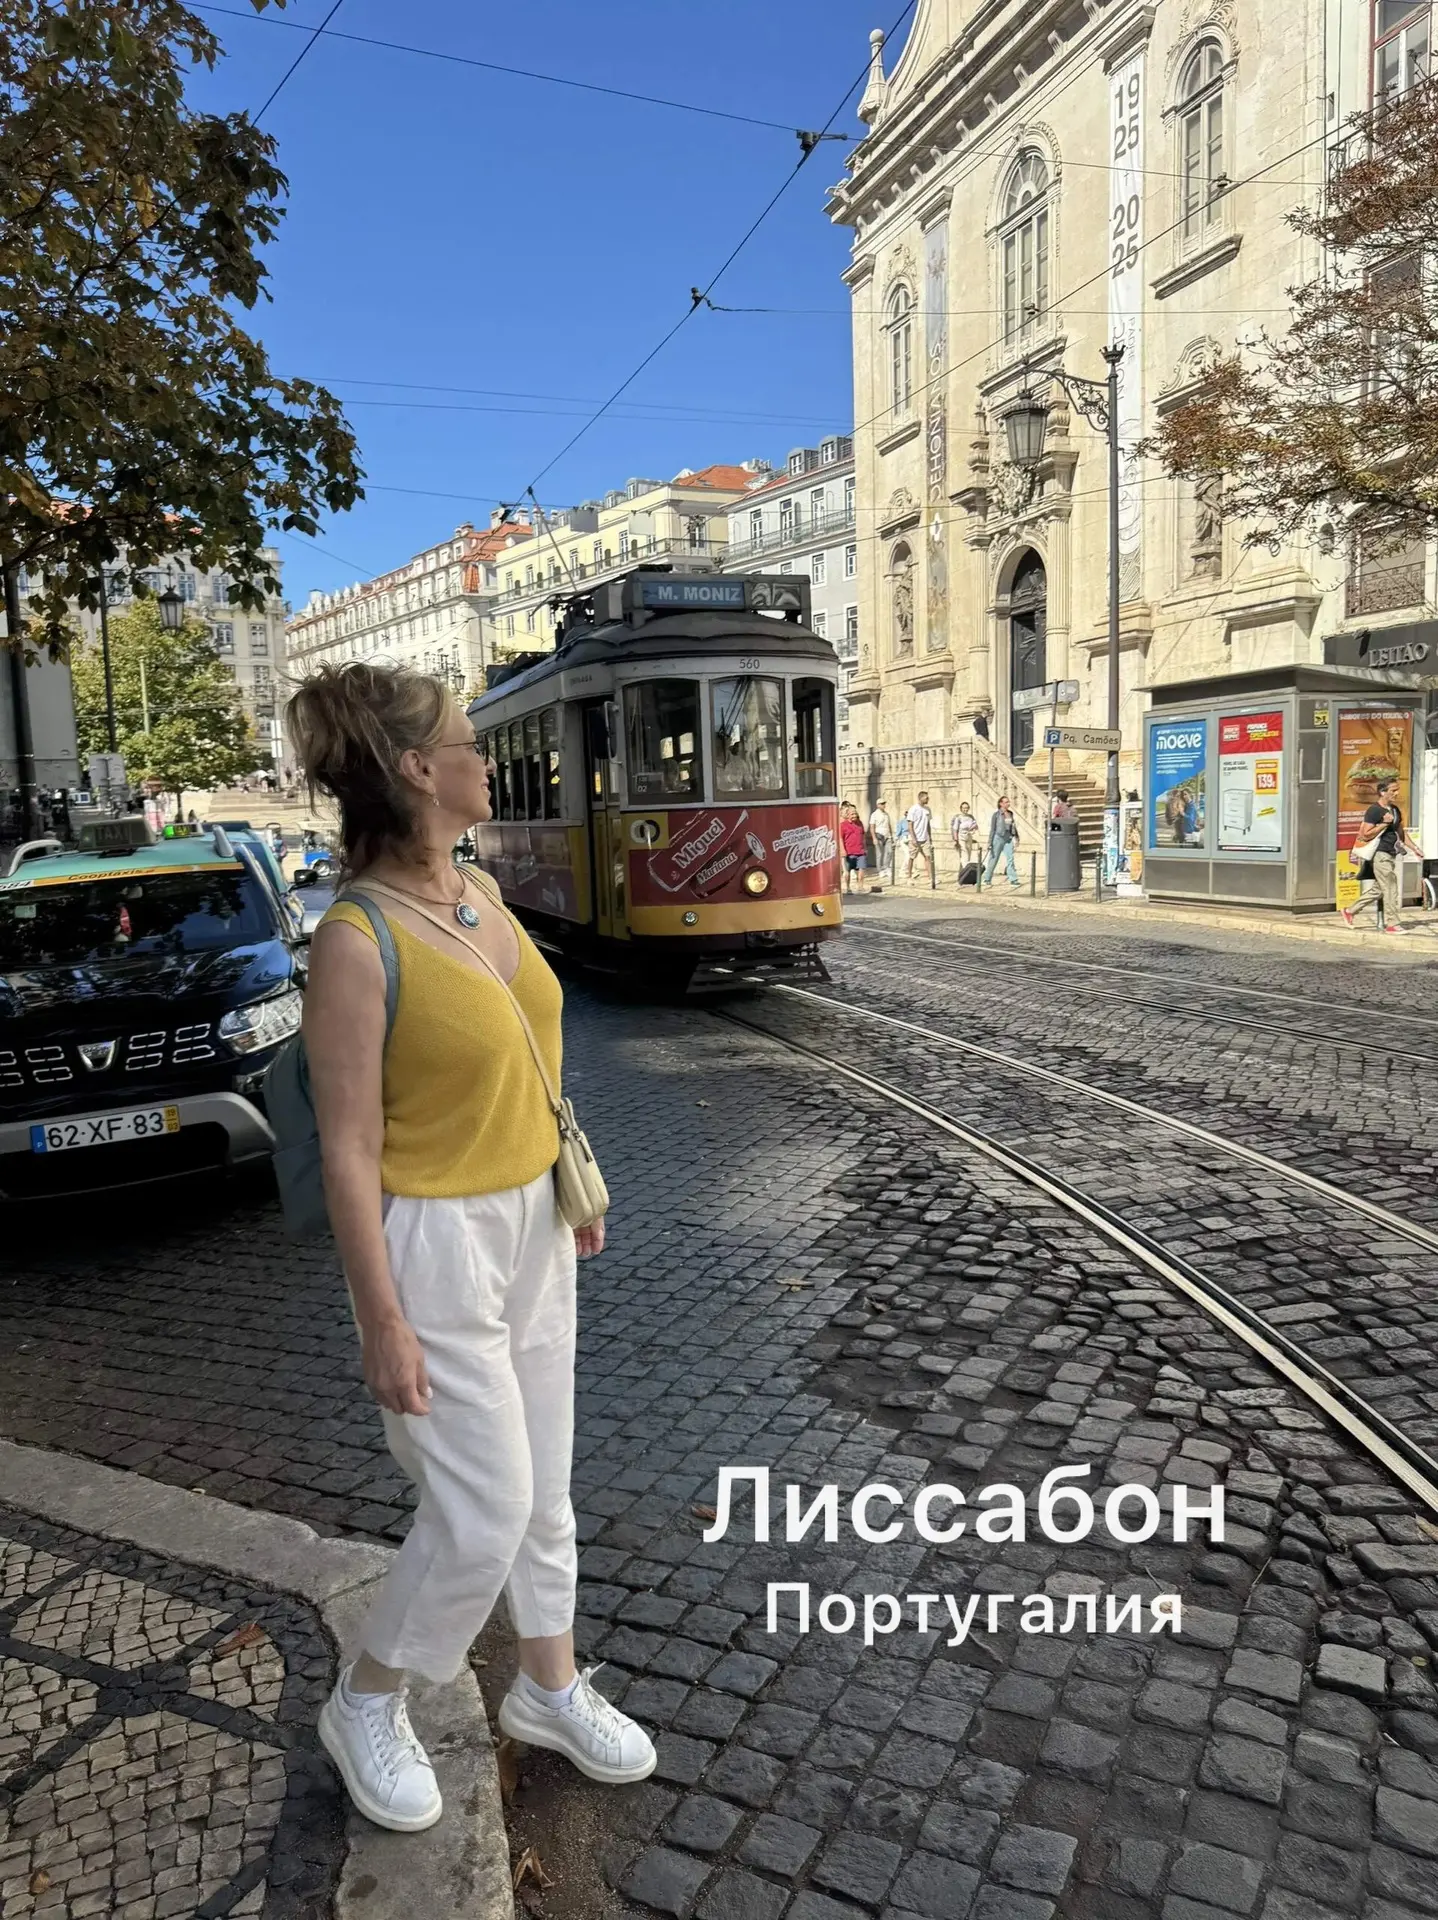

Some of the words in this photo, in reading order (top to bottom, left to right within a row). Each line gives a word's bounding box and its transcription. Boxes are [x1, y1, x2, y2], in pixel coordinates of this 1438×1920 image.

[1114, 72, 1140, 119] 19
[1114, 113, 1139, 161] 25
[1112, 194, 1140, 241] 20
[1111, 233, 1139, 280] 25
[657, 586, 679, 600] M.
[684, 586, 742, 601] MONIZ
[739, 659, 760, 669] 560
[1368, 642, 1430, 667] LEITÃO
[1063, 733, 1078, 745] Pq.
[1083, 734, 1119, 745] Camões
[1156, 733, 1203, 750] moeve
[96, 825, 127, 842] TAXI
[673, 818, 726, 868] Miguel
[698, 854, 737, 883] Mariana
